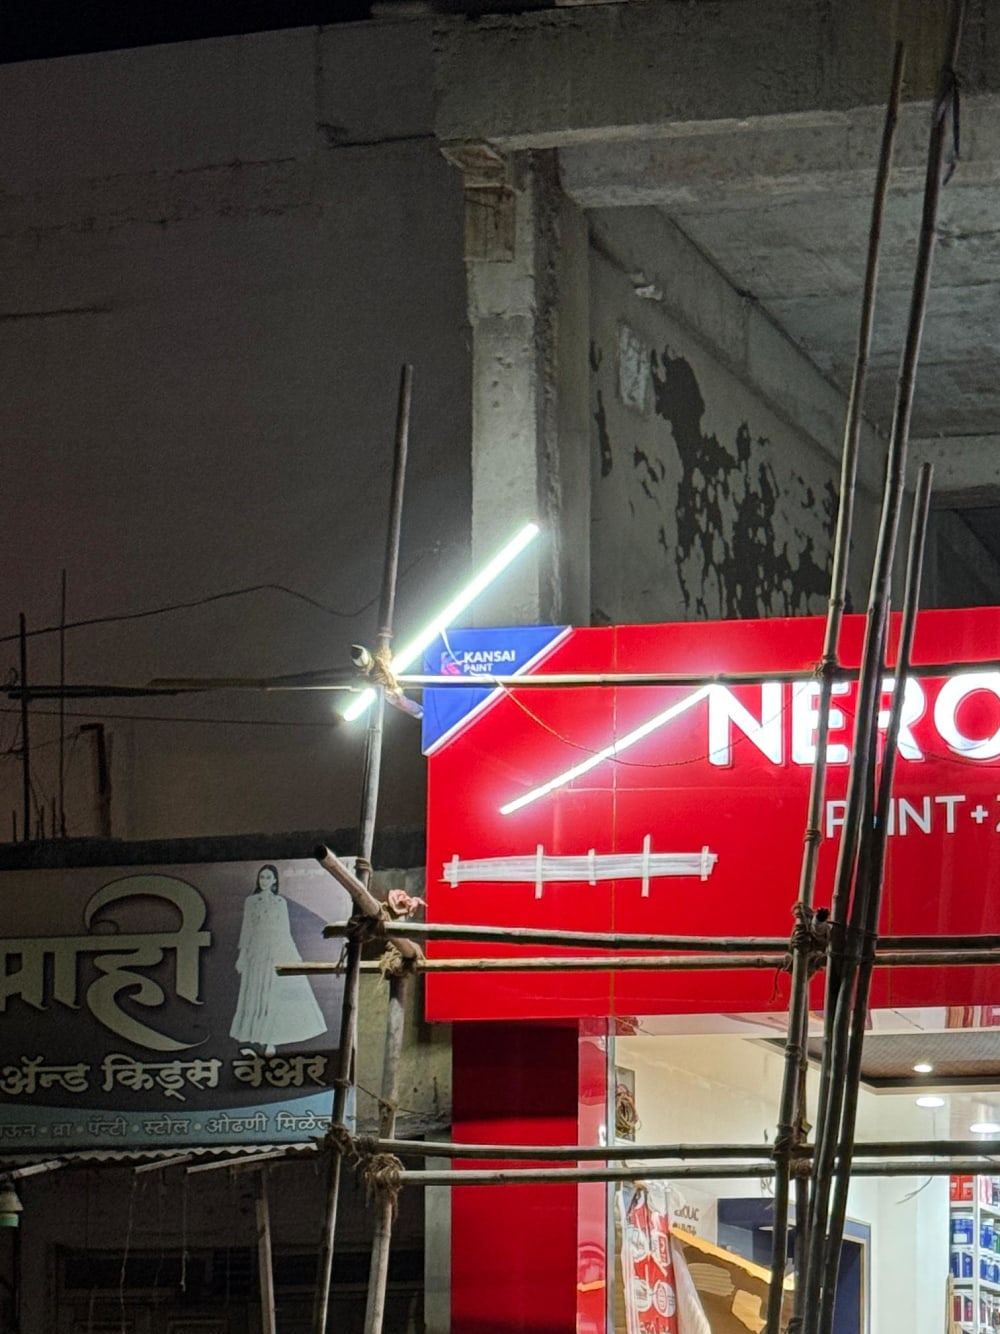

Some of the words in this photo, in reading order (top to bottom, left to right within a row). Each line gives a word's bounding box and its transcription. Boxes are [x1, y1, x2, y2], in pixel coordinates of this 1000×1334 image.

[462, 649, 516, 663] KANSAI
[233, 1048, 327, 1088] वेअर
[206, 1111, 268, 1133] ओढणी
